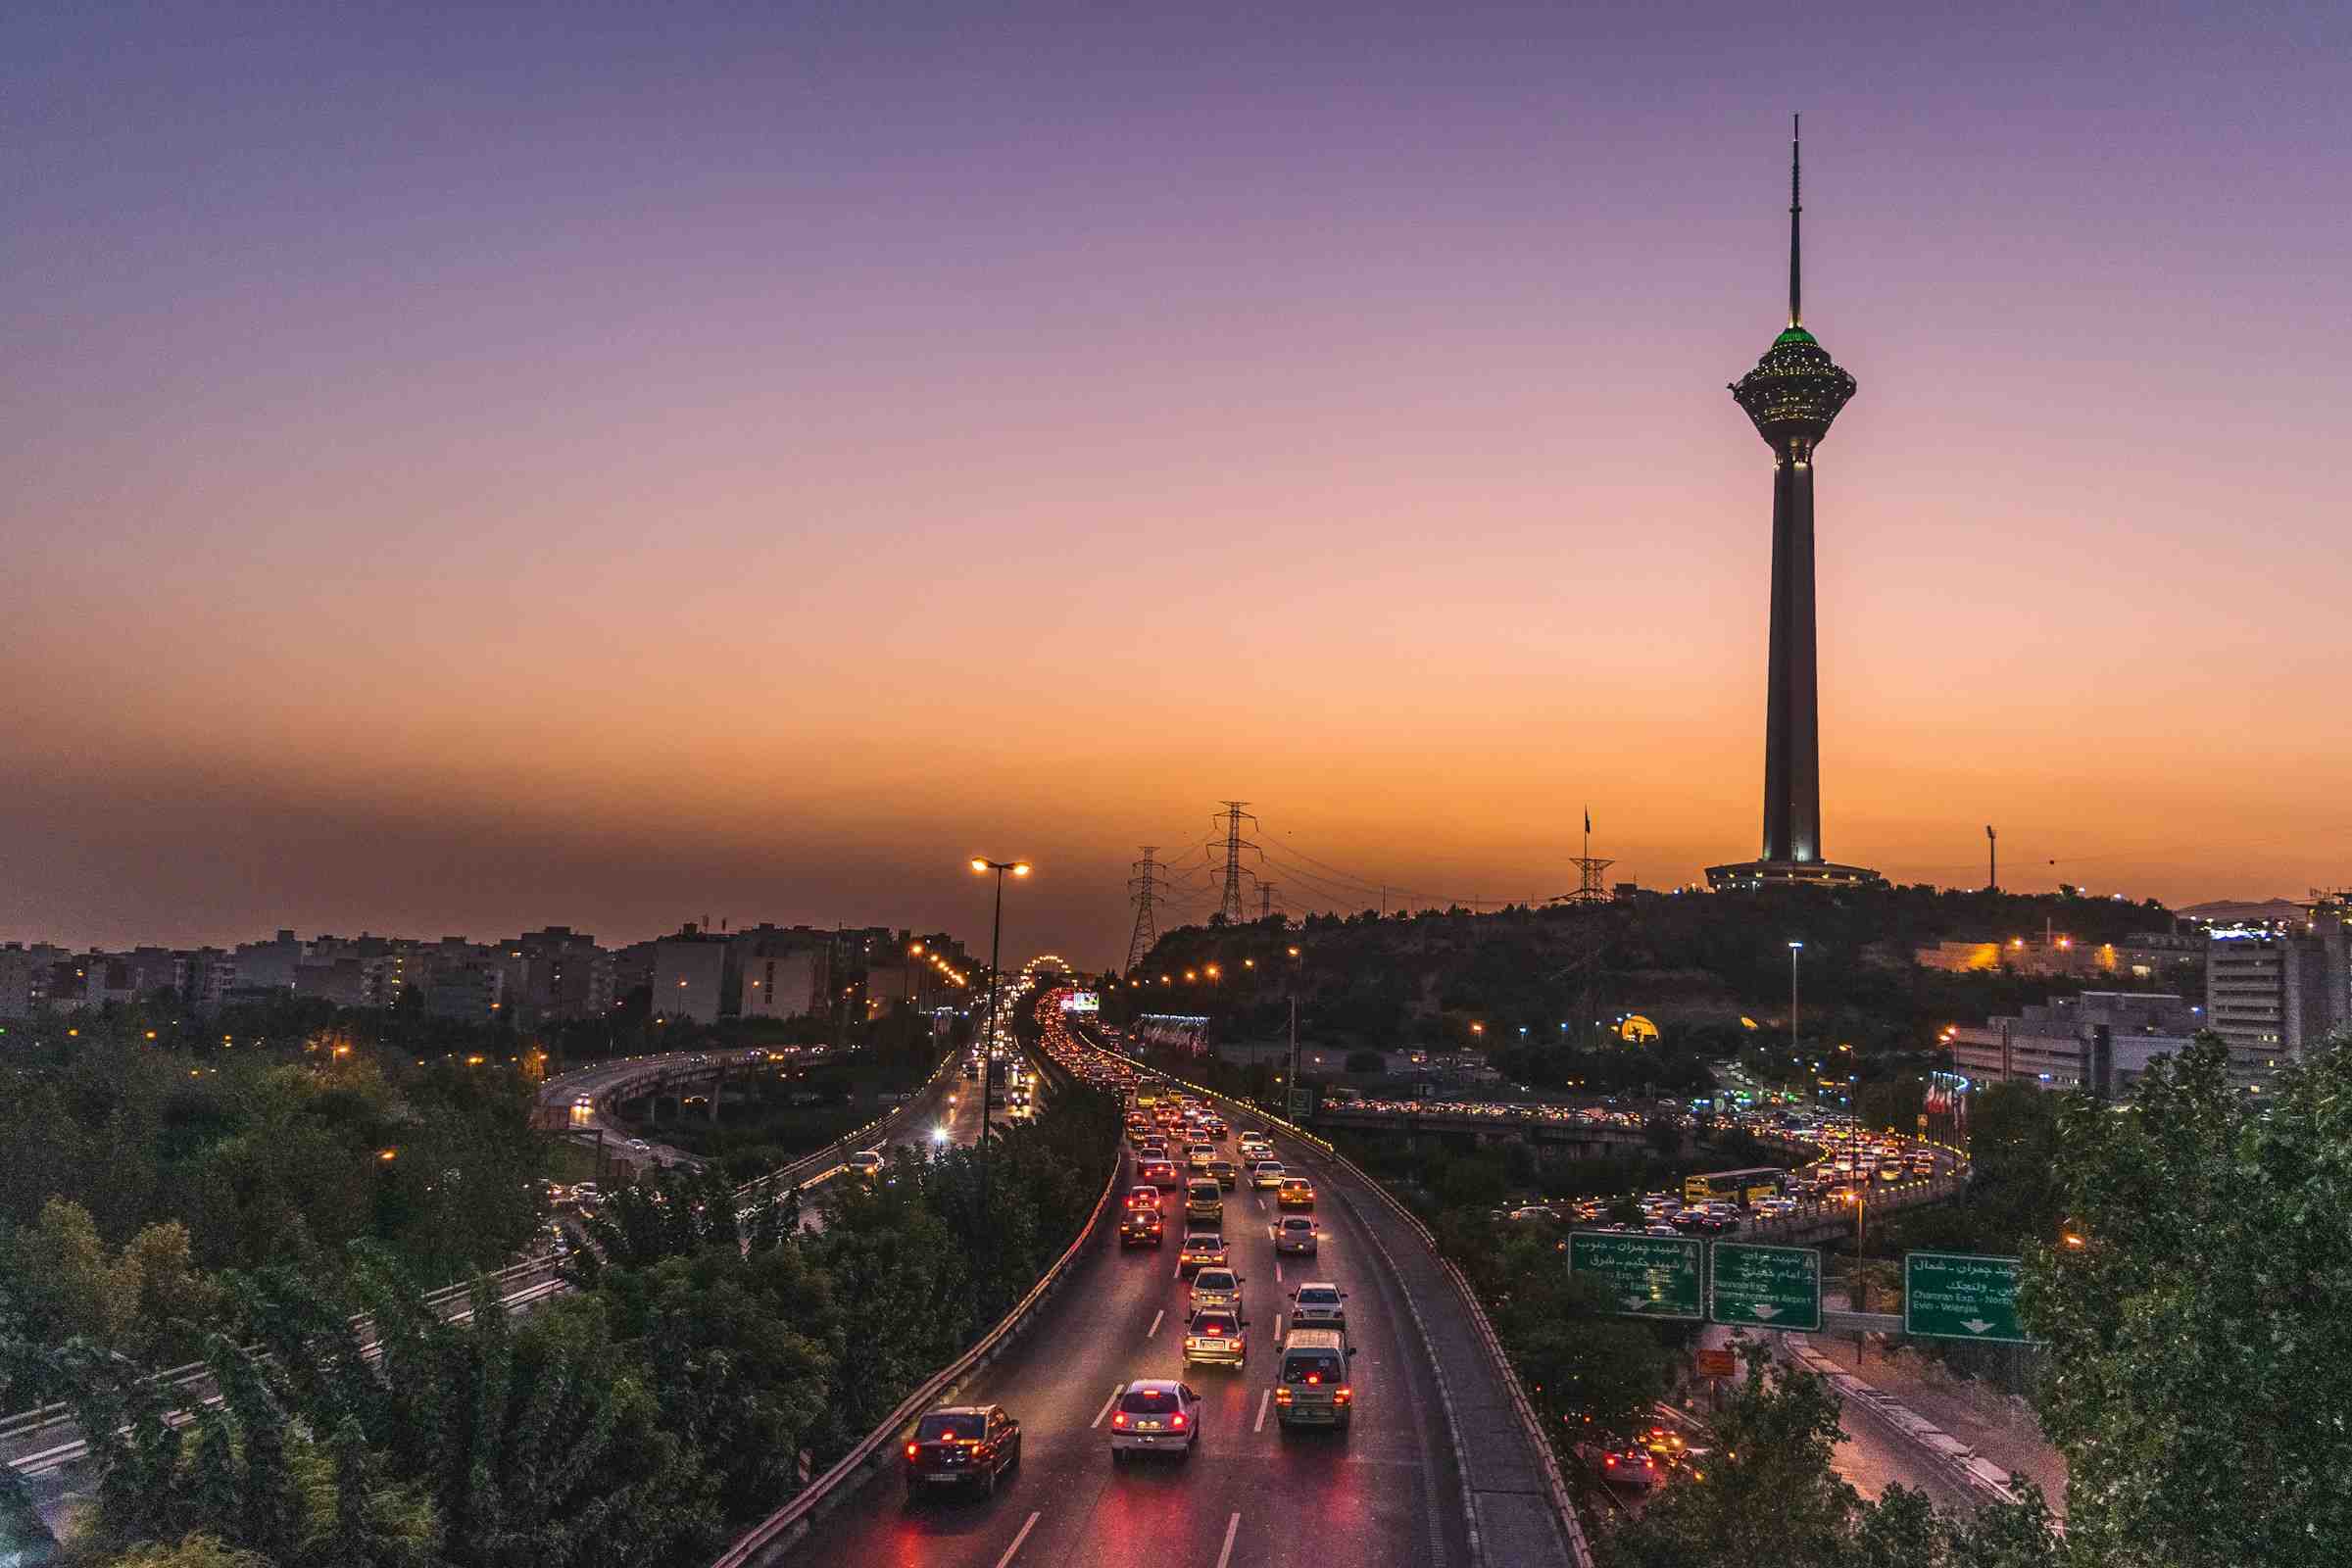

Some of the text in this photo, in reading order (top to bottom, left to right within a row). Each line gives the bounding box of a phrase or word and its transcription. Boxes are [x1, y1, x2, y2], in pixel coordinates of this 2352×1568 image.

[1617, 1241, 1650, 1255] چمران
[1653, 1243, 1680, 1254] شهید
[1914, 1259, 1946, 1271] شمال
[1957, 1261, 1992, 1278] چمران
